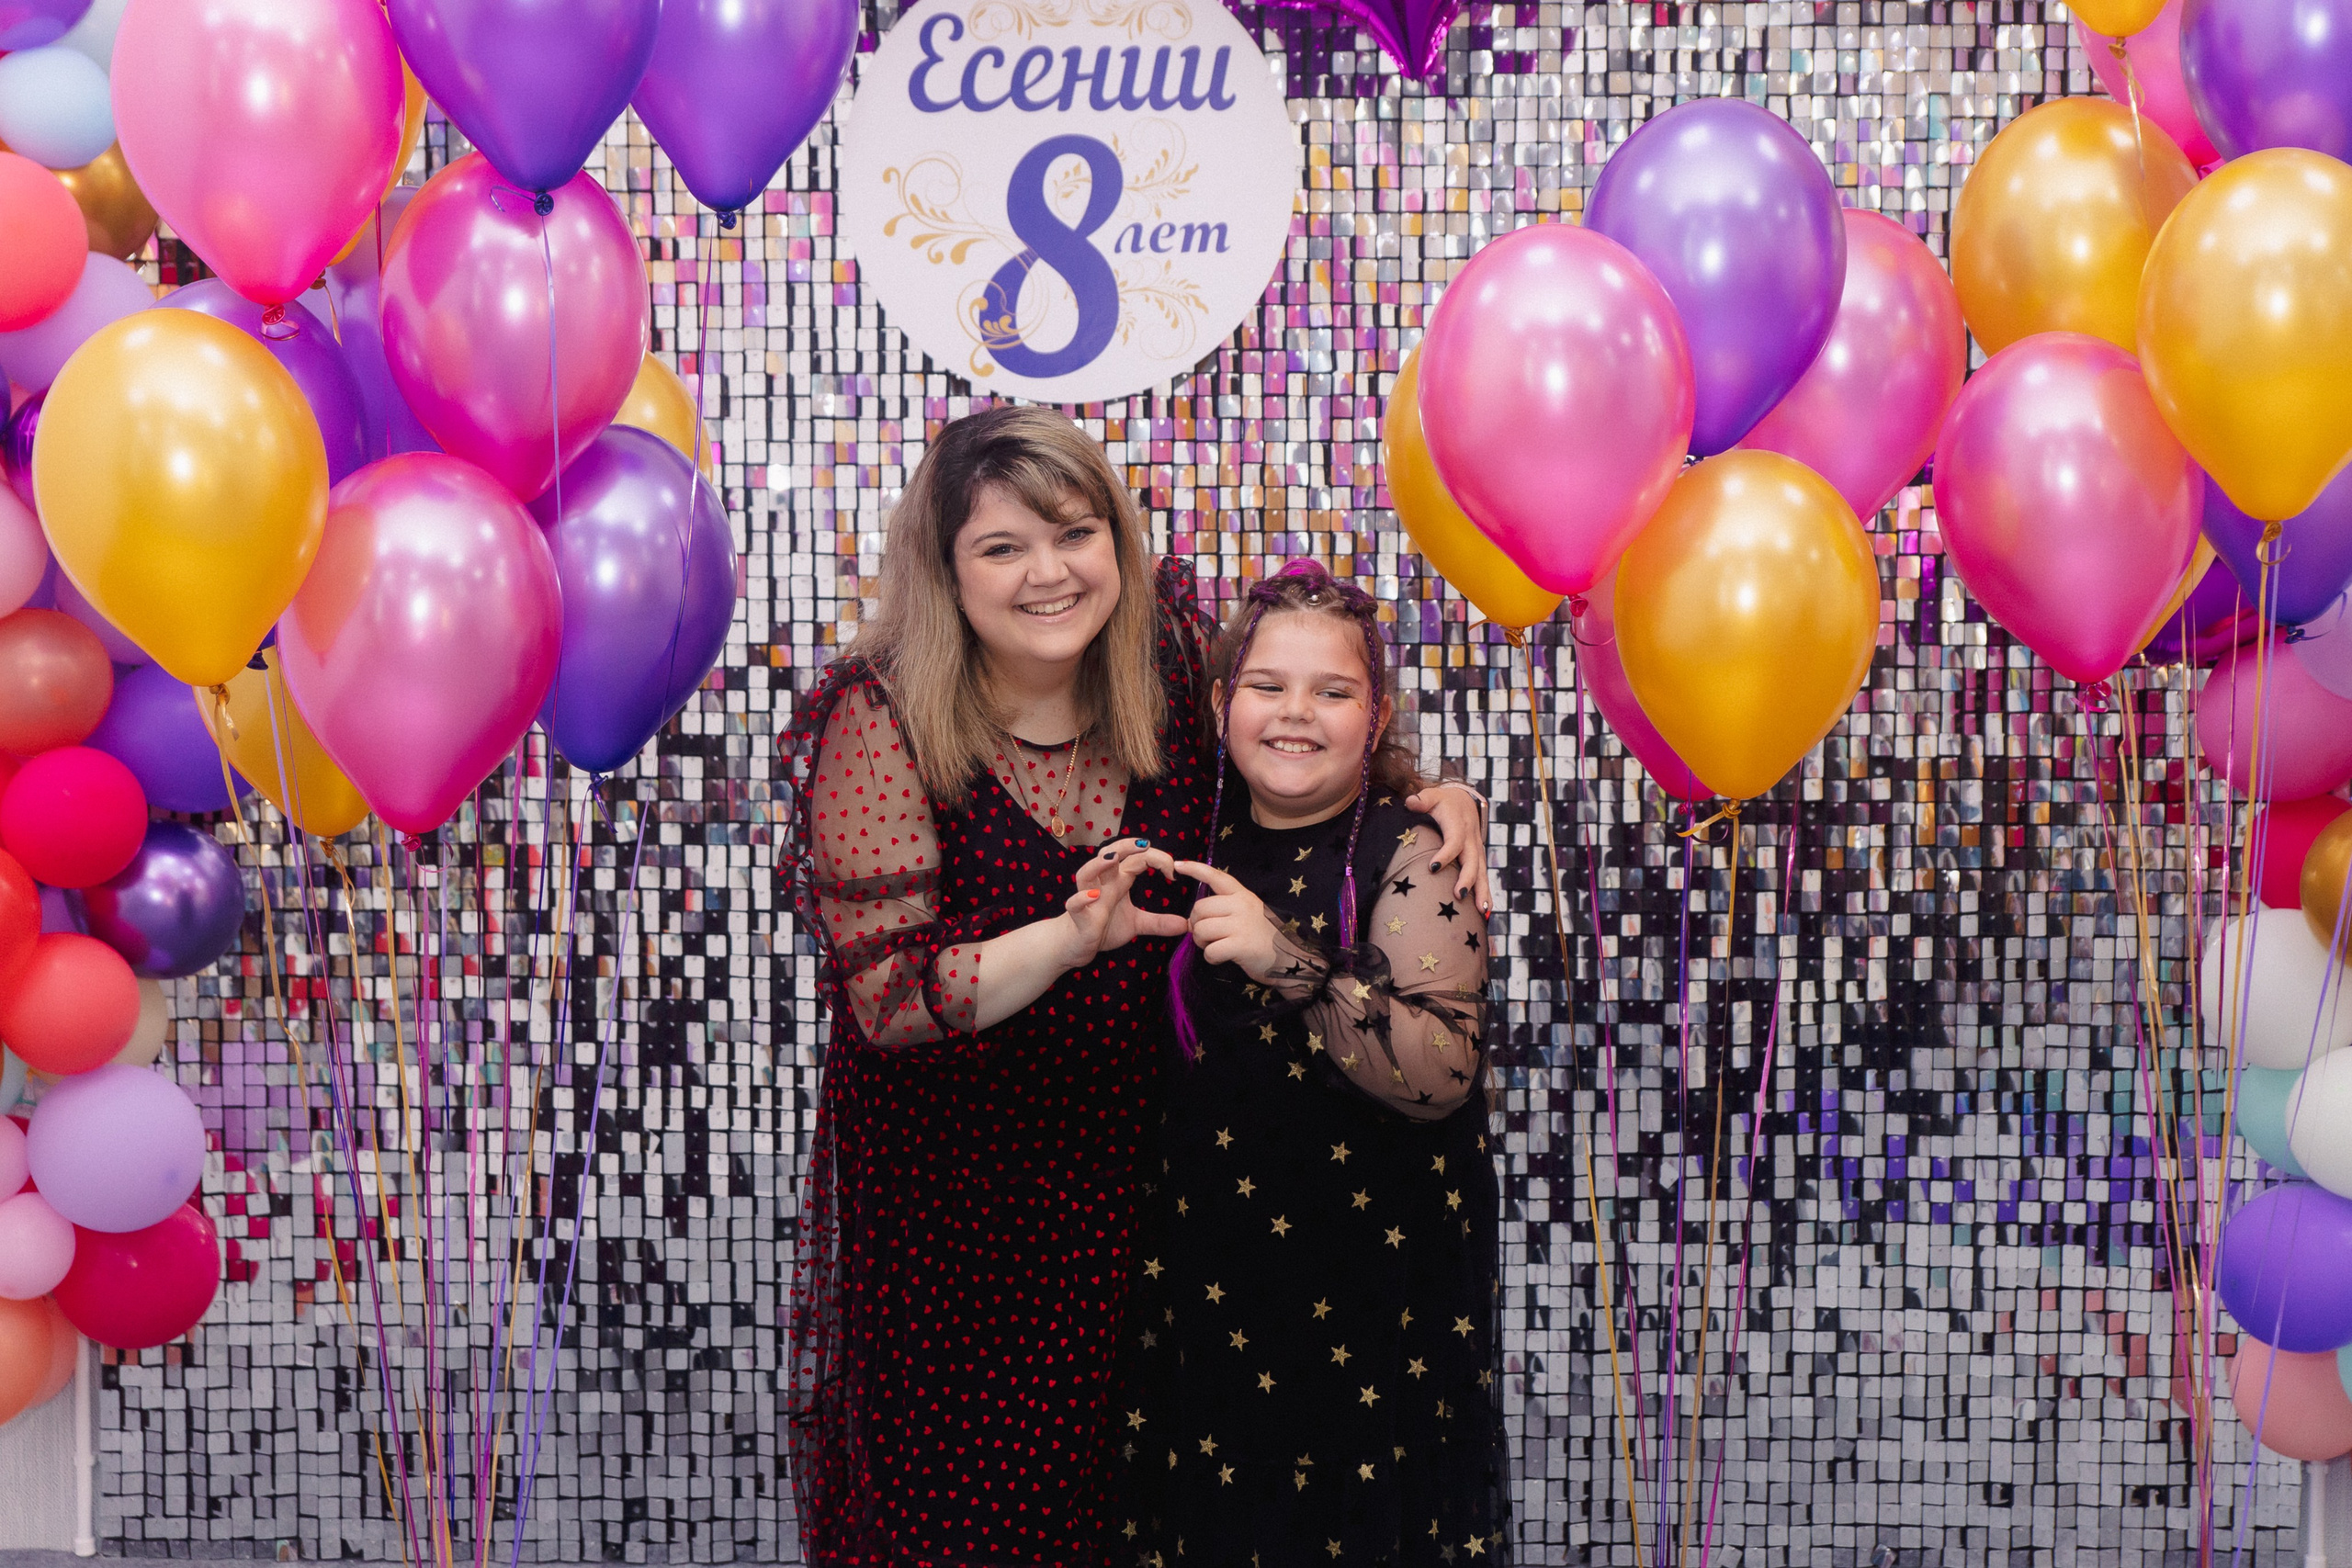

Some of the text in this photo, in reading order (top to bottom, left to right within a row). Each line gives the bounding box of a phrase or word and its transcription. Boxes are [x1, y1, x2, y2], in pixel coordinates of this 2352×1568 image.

[908, 12, 1237, 113] Есении
[979, 133, 1231, 378] 8 лет
